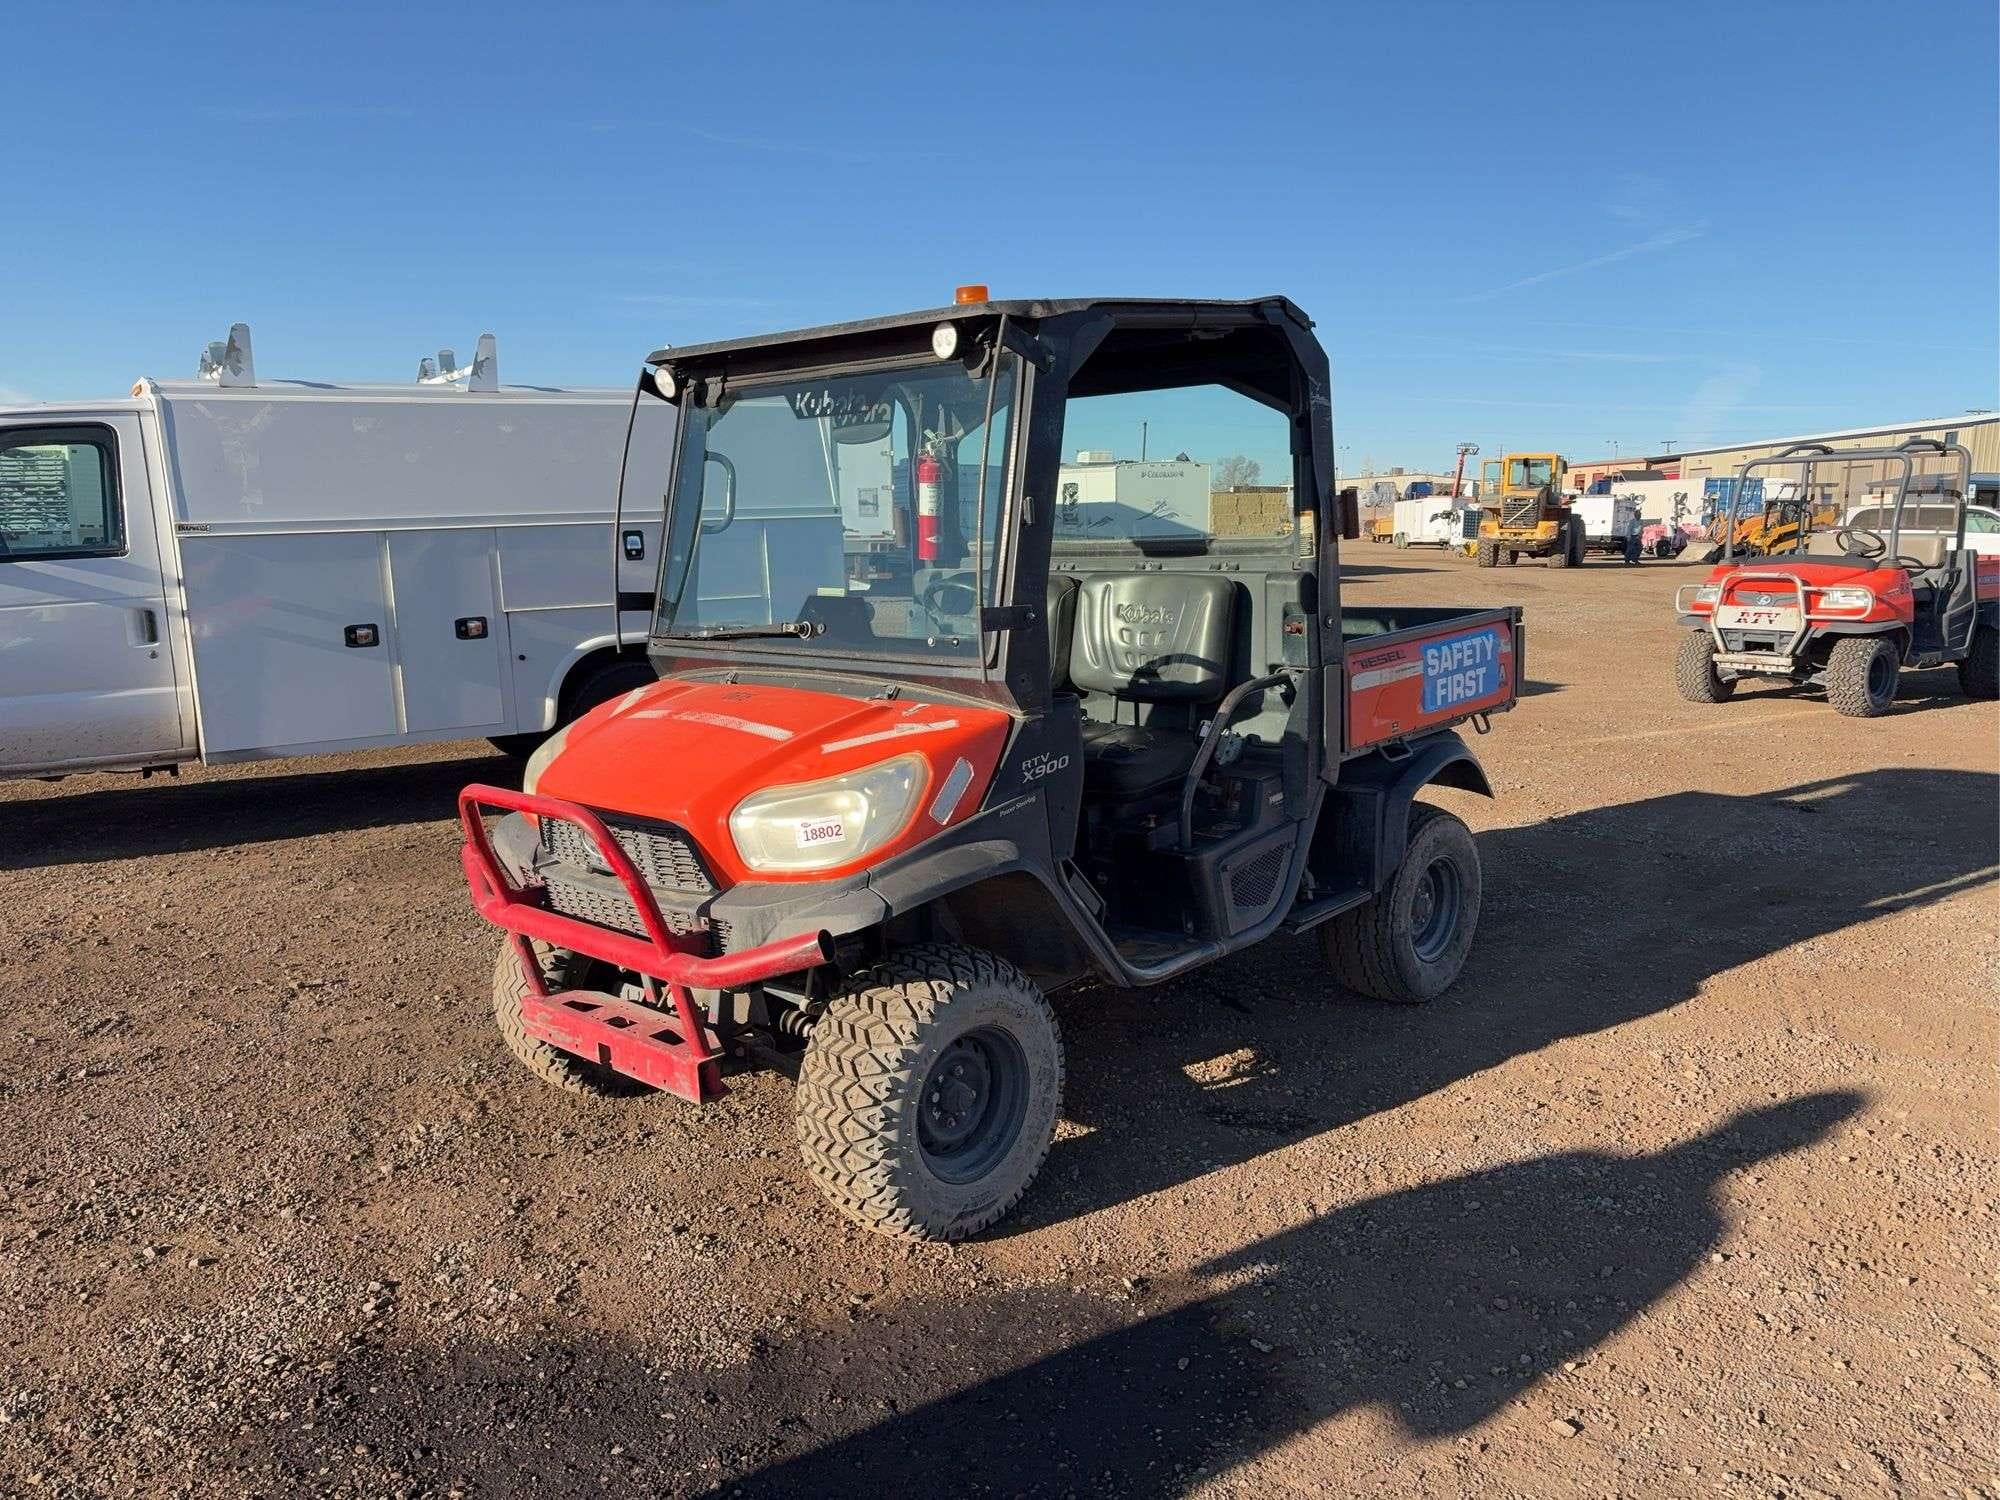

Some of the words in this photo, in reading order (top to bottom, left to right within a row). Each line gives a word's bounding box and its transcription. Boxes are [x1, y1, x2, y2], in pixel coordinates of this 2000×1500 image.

[1116, 603, 1174, 624] Kubota
[1427, 634, 1494, 677] SAFETY
[1436, 667, 1487, 706] FIRST
[1022, 752, 1050, 770] RTV
[1022, 755, 1069, 783] X900
[803, 824, 843, 841] 18802
